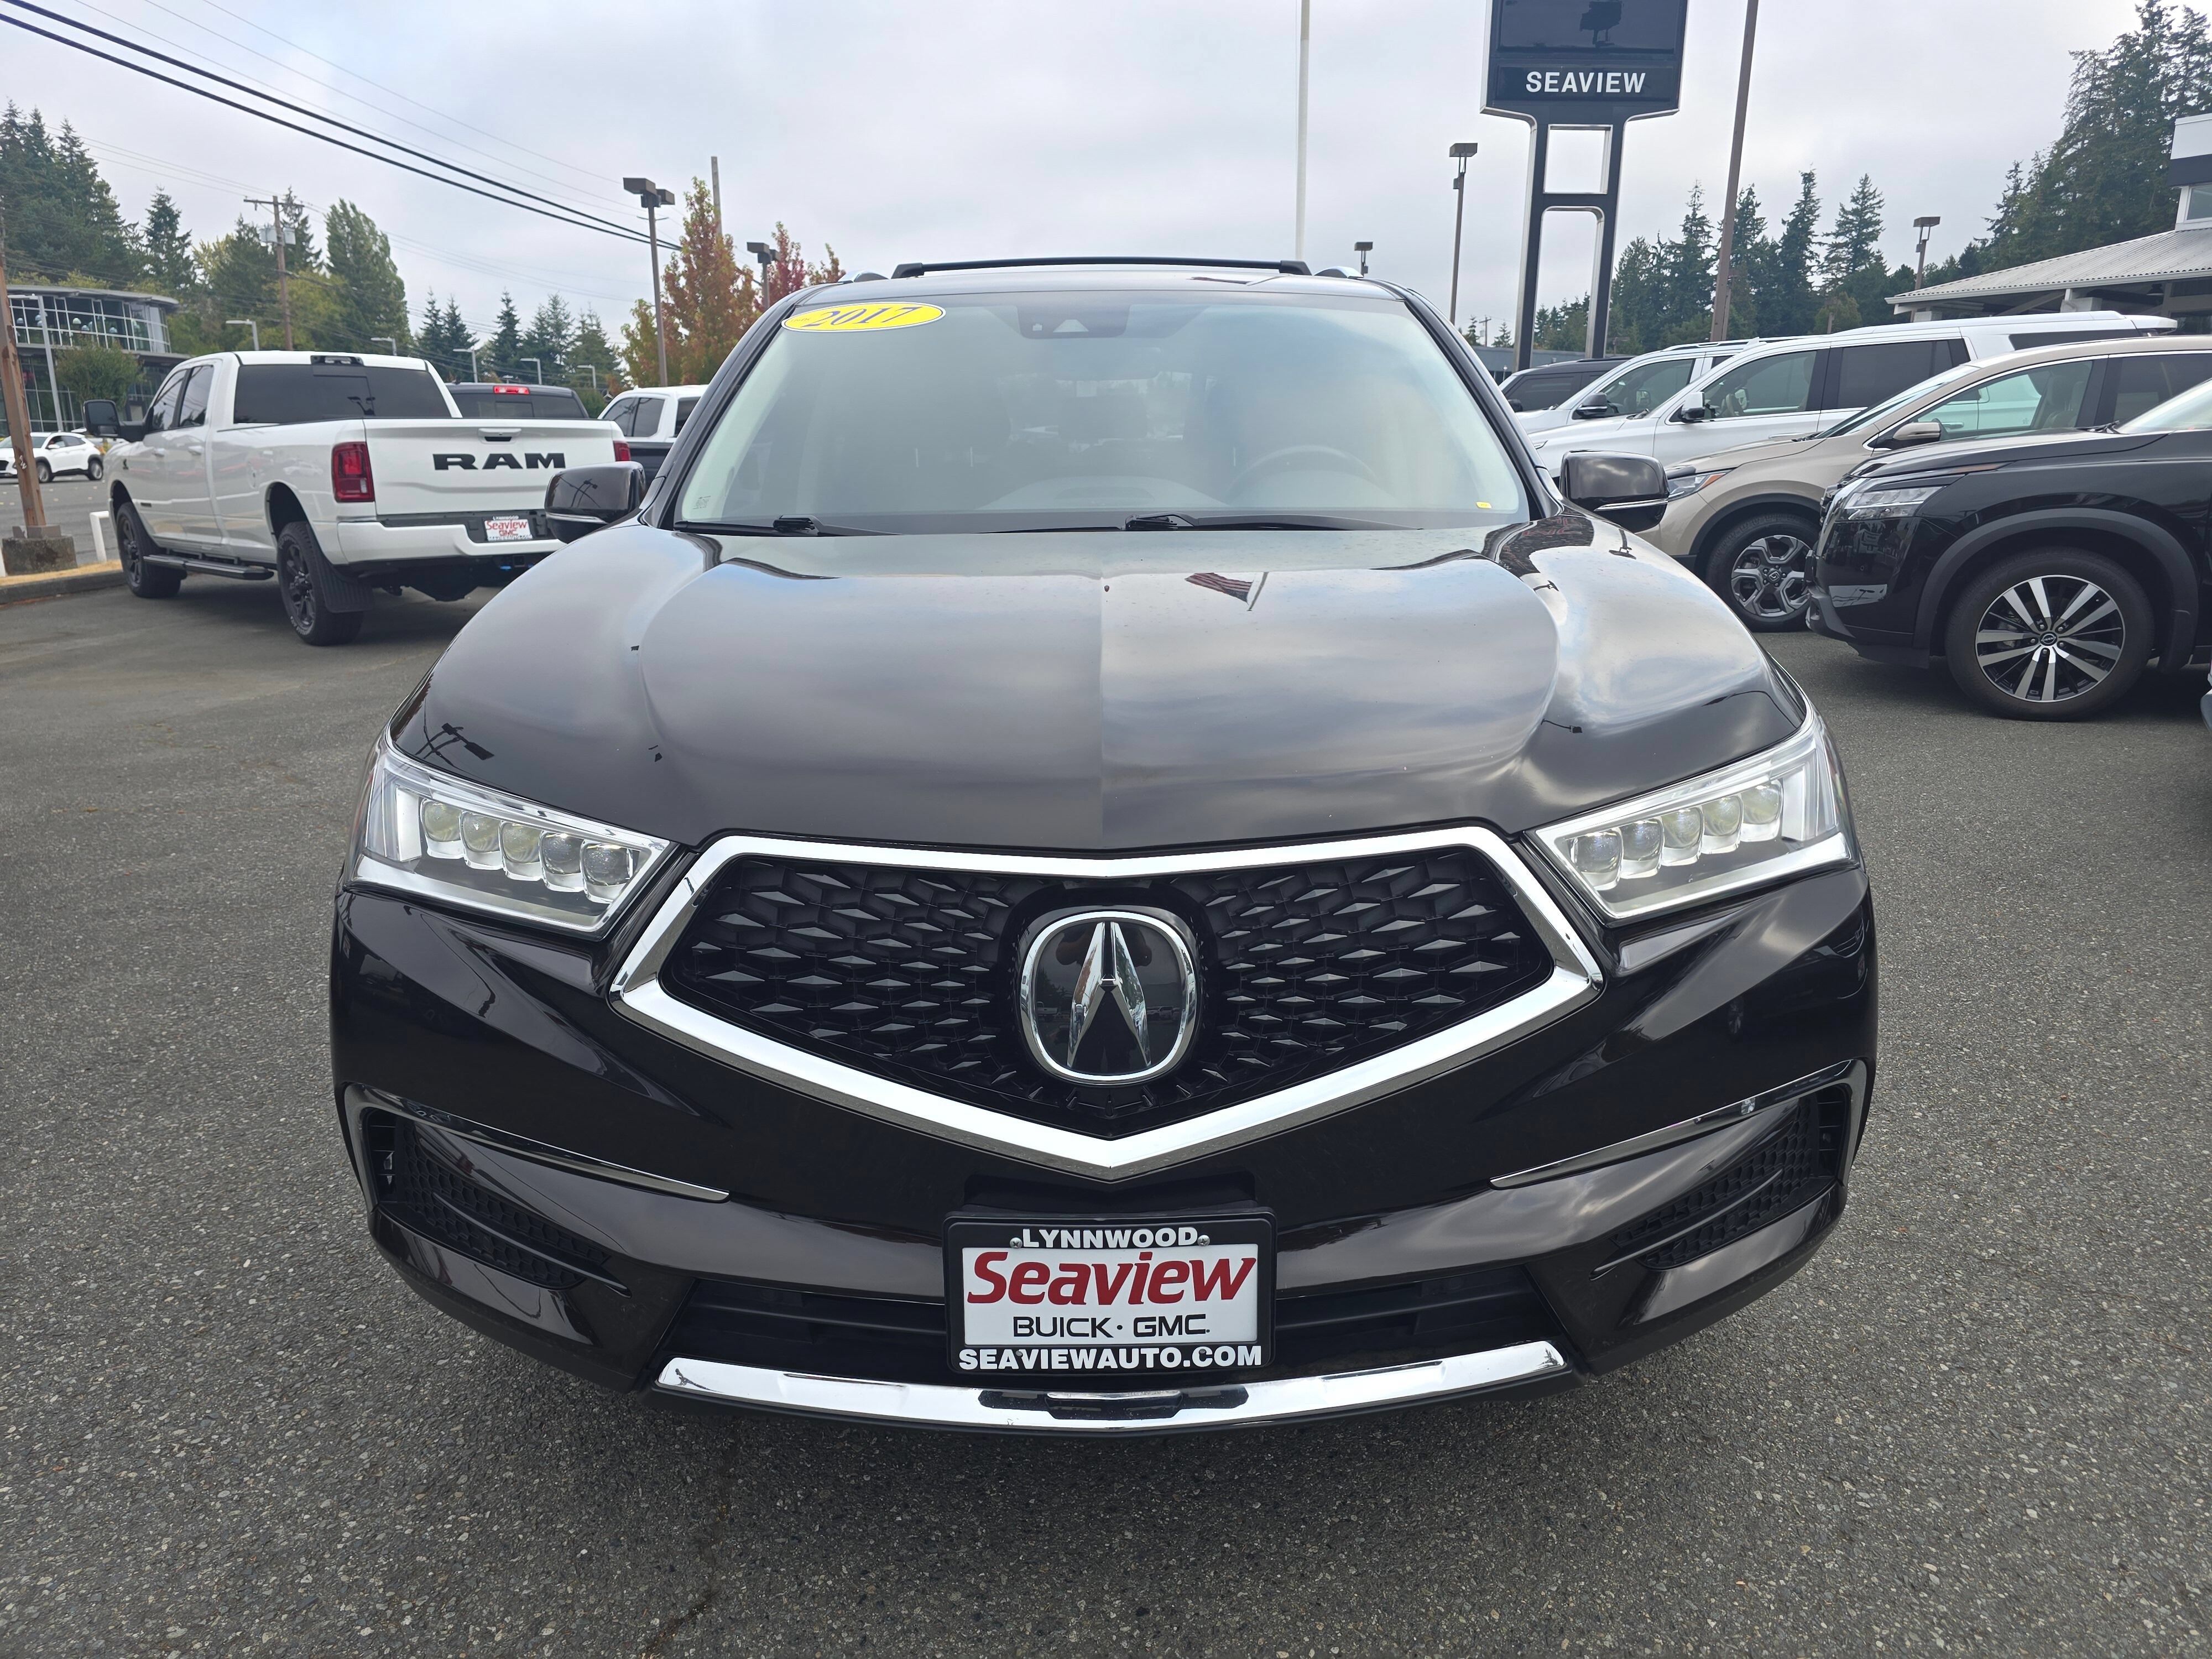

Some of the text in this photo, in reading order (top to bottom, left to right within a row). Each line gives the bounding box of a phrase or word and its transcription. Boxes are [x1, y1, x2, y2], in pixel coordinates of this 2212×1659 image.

[1525, 71, 1646, 93] SEAVIEW
[800, 306, 923, 328] 2017
[432, 453, 566, 470] RAM
[486, 520, 528, 530] Seaview
[1022, 1227, 1198, 1248] LYNNWOOD
[967, 1251, 1257, 1306] Seaview
[1013, 1316, 1114, 1338] BUICK
[958, 1345, 1262, 1370] SEAVIEWAUTO.COM
